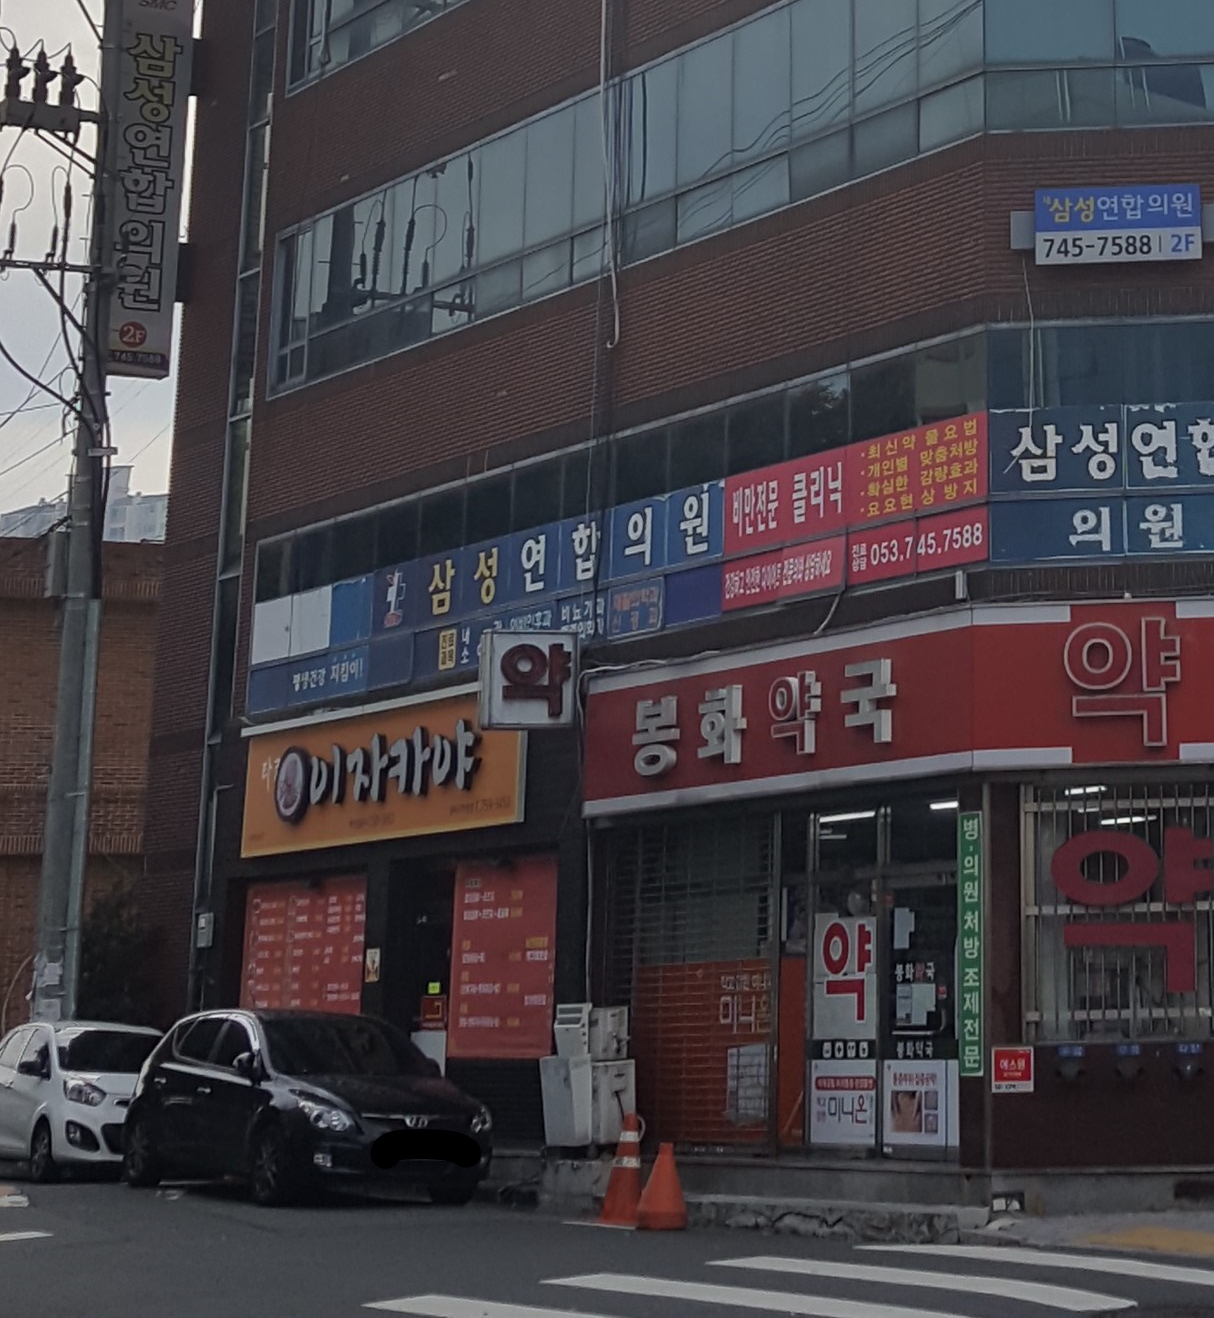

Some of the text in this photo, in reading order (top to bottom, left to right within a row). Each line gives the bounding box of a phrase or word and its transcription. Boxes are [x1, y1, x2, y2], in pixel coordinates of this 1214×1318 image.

[115, 33, 182, 312] 삼성연합의원
[1043, 234, 1195, 258] 745-7588 2F
[122, 325, 146, 343] 2F
[733, 462, 843, 537] 비만전문 클리닉
[868, 456, 908, 477] 개인별
[921, 457, 978, 486] 감량효과
[870, 522, 983, 566] 053.745.7588
[1069, 503, 1184, 551] 의원
[501, 643, 572, 717] 약
[632, 657, 897, 777] 봉화약국
[1063, 616, 1181, 747] 약
[1051, 826, 1214, 993] 약
[823, 922, 872, 1021] 약
